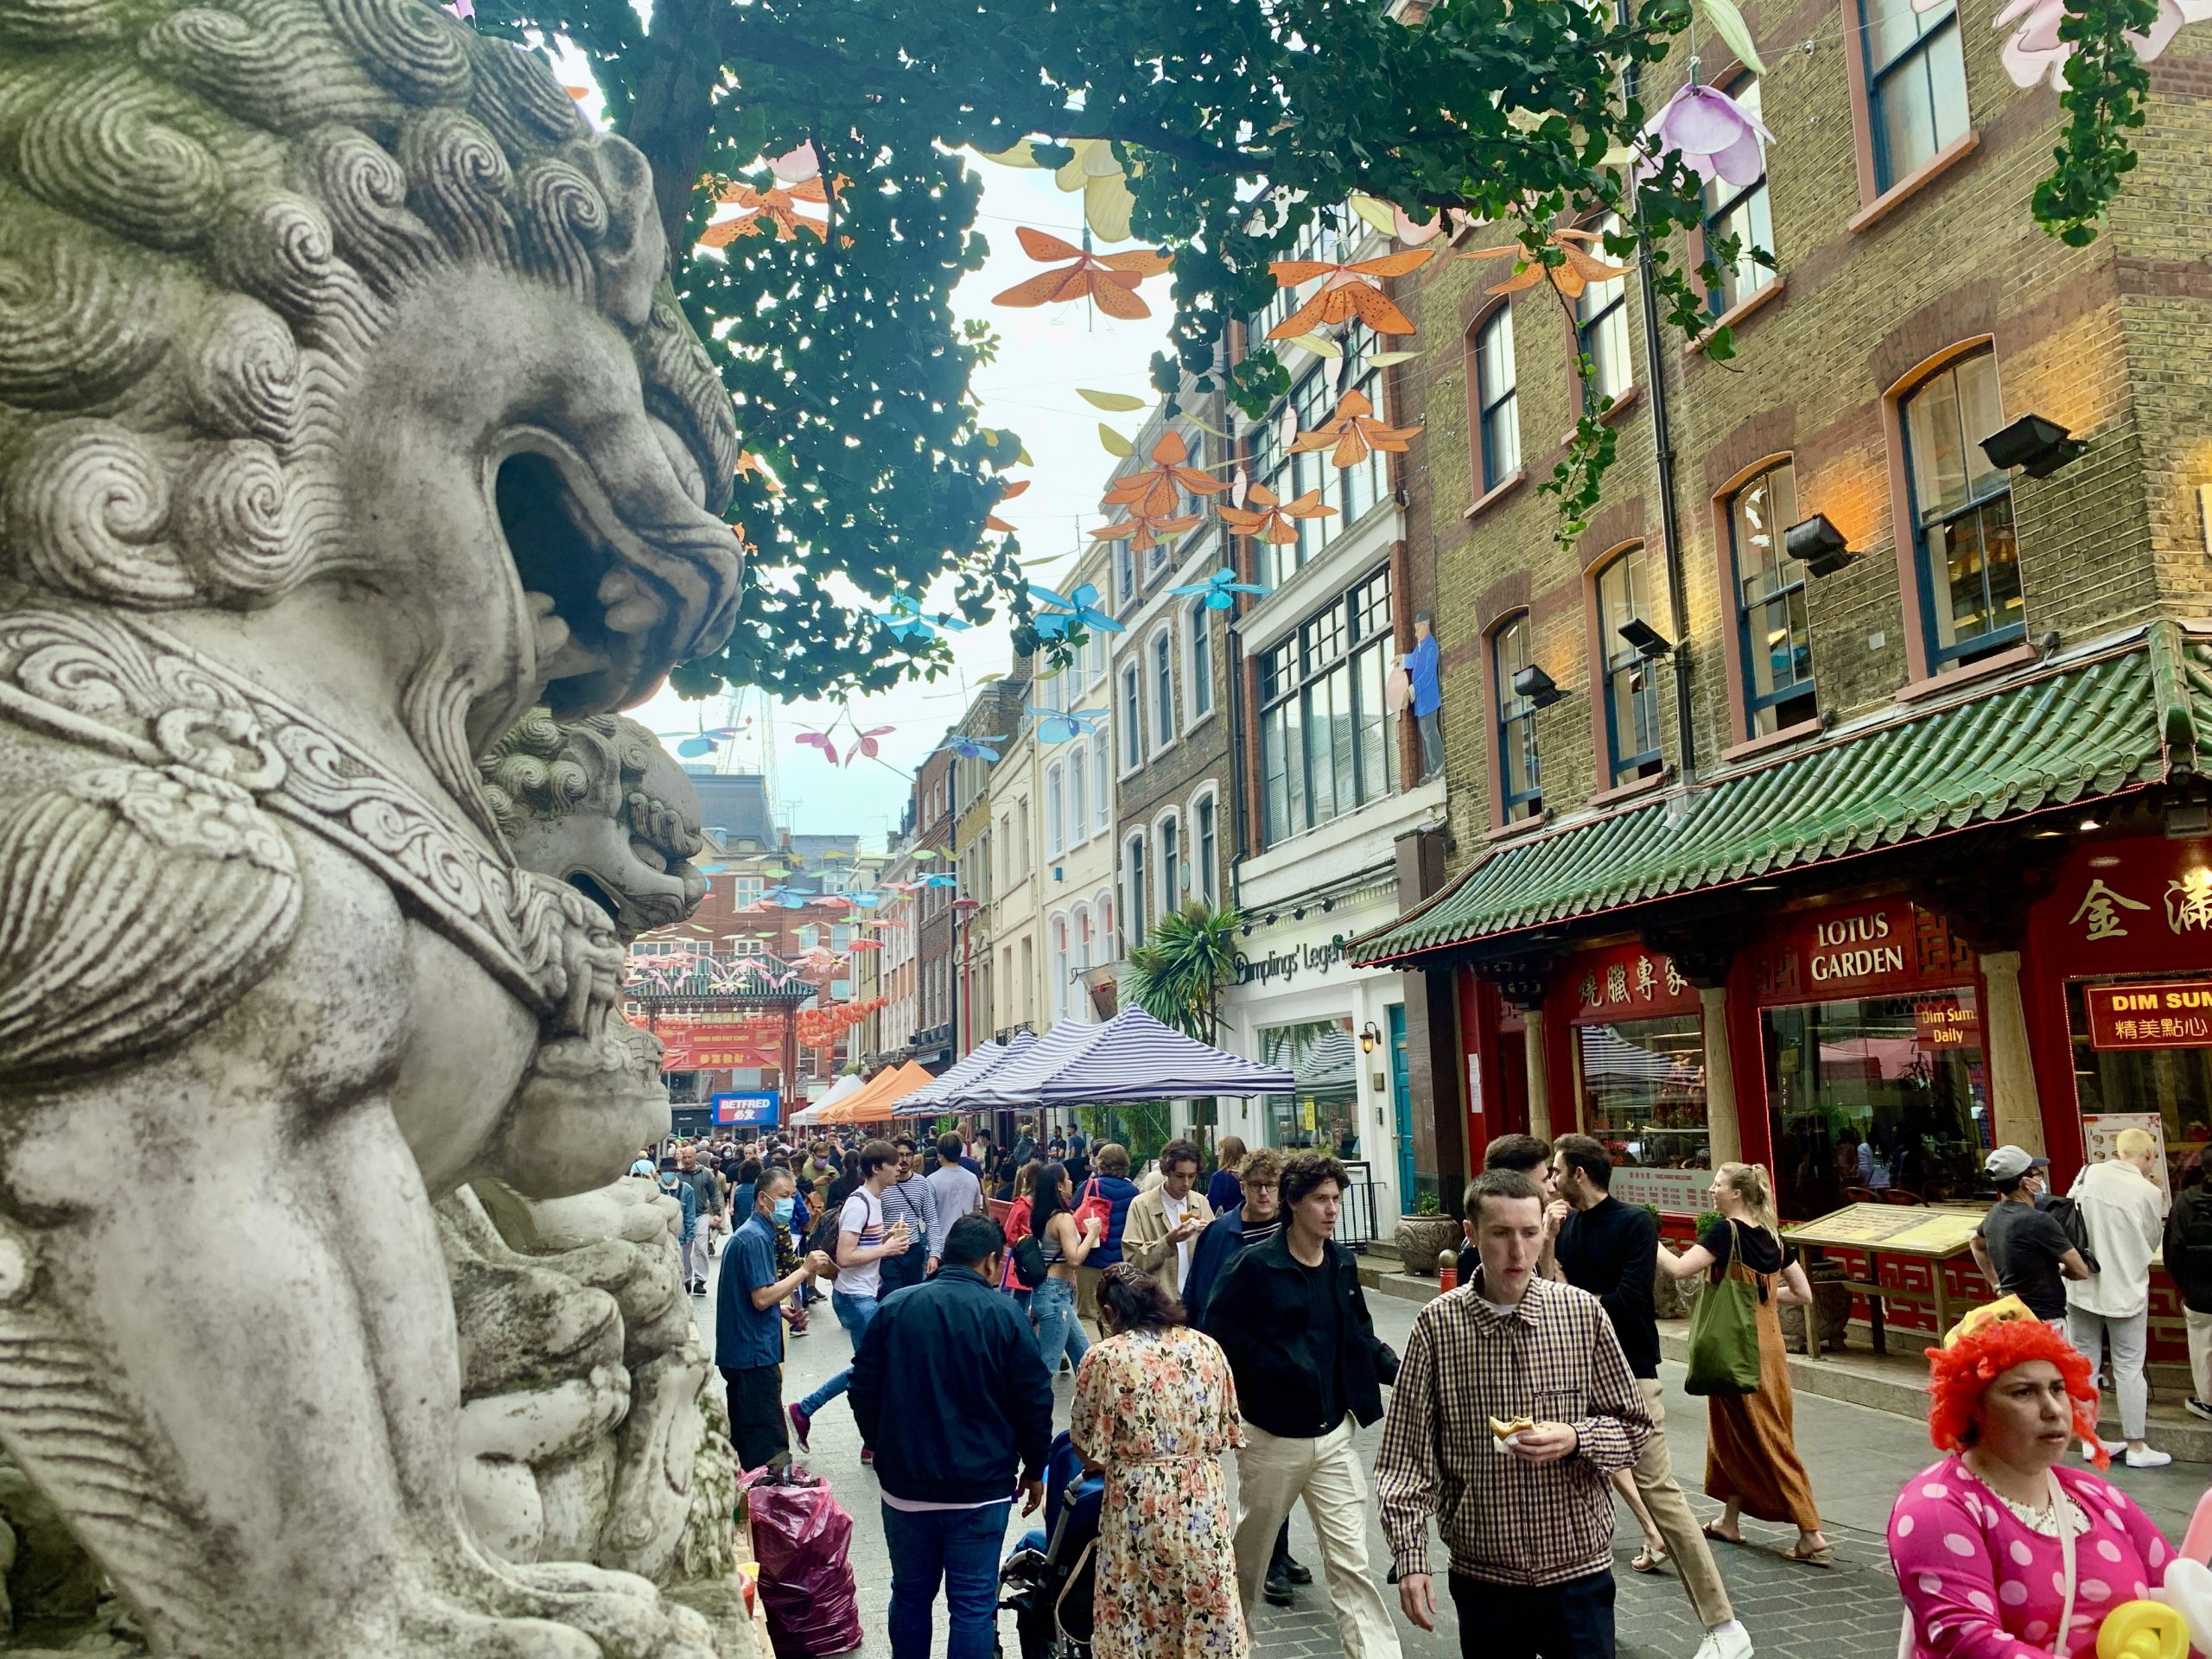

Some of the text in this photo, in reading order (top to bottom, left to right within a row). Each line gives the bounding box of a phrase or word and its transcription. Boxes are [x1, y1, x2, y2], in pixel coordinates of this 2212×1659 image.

[1818, 912, 1889, 947] LOTUS
[1303, 930, 1354, 974] Legen
[1811, 945, 1904, 982] GARDEN
[2112, 994, 2158, 1011] DIM
[1922, 1007, 1974, 1023] Dim Sum
[1934, 1028, 1963, 1044] Daily
[2114, 1016, 2209, 1040] 精美點心
[721, 1099, 771, 1109] BETFRED
